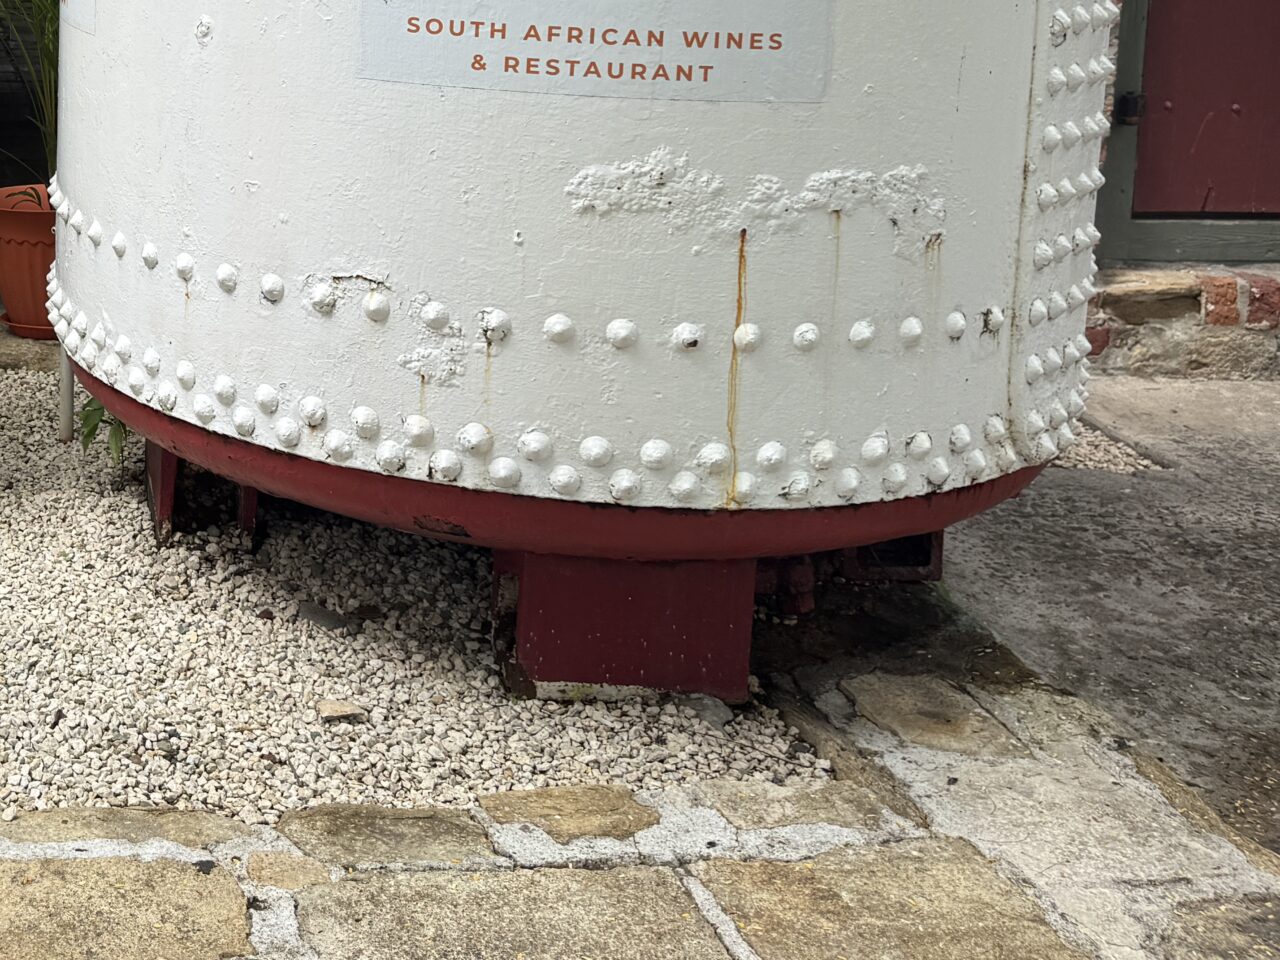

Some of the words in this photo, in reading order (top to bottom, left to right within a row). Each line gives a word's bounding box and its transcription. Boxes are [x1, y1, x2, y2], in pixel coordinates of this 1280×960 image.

[406, 16, 508, 41] SOUTH
[522, 24, 666, 49] AFRICAN
[681, 30, 785, 52] WINES
[470, 53, 488, 73] &
[503, 55, 716, 83] RESTAURANT
